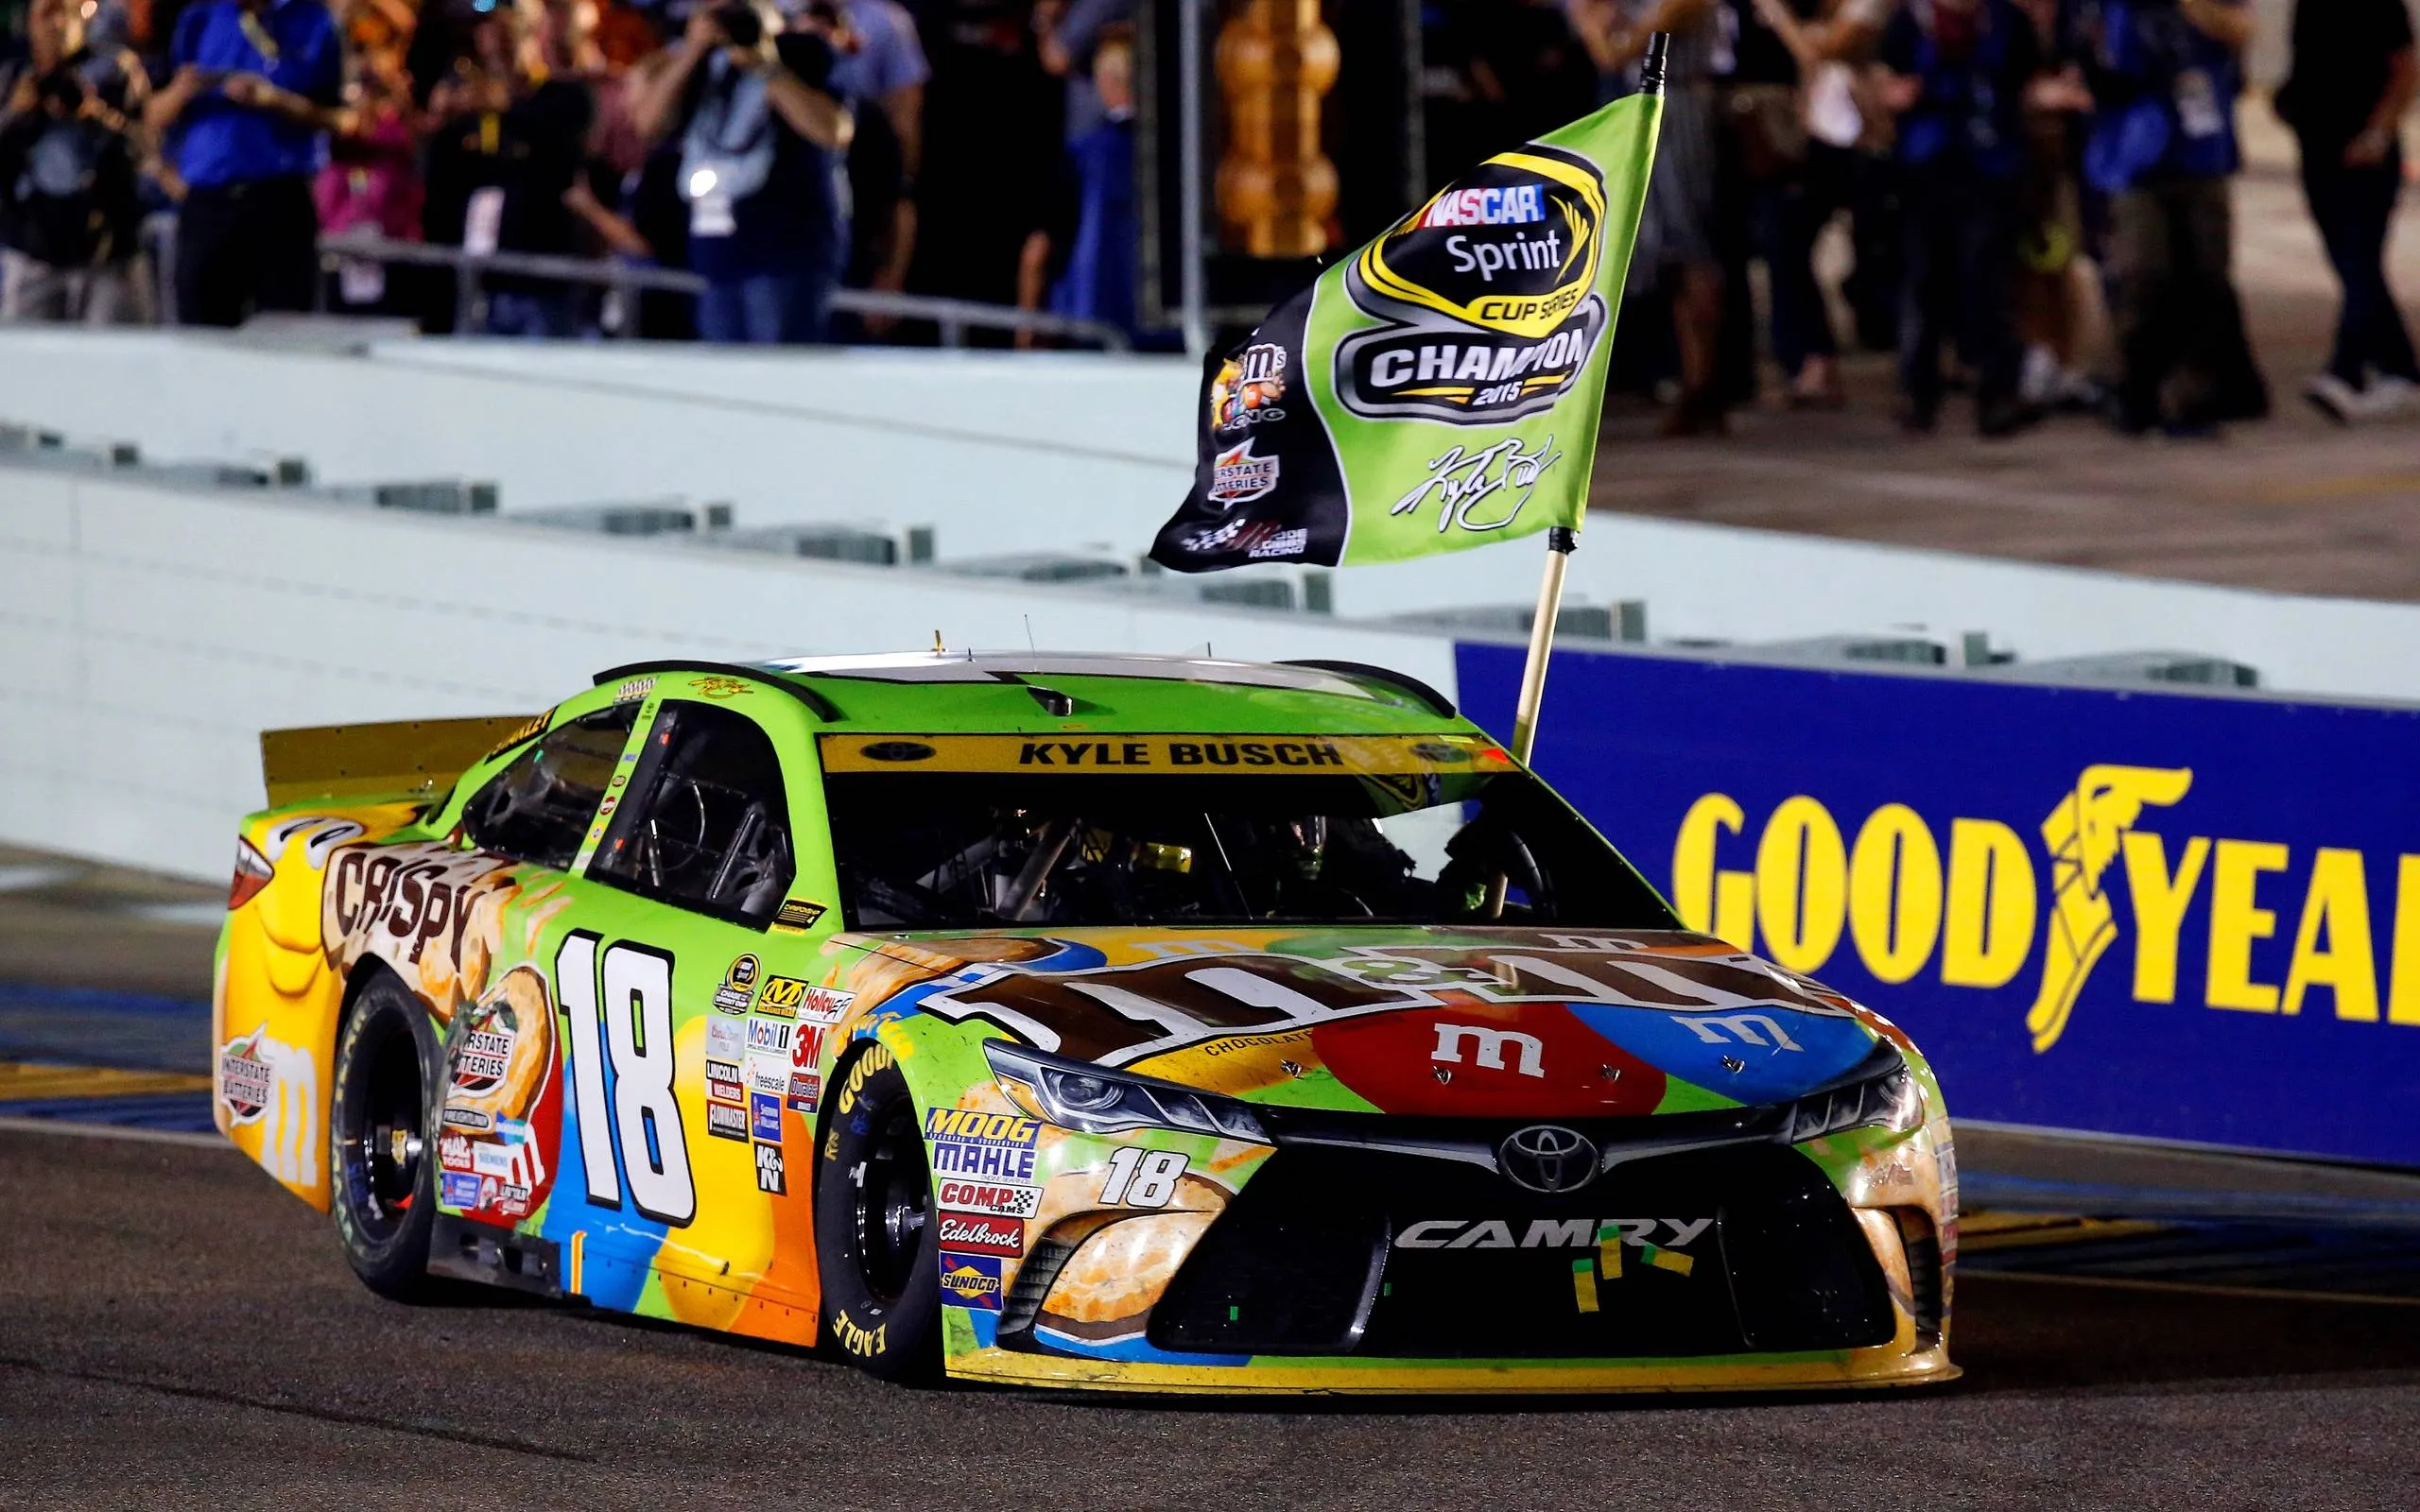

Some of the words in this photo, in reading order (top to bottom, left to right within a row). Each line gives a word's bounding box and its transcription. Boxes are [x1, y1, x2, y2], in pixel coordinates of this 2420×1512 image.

[1425, 185, 1540, 227] NASCAR
[1445, 230, 1561, 282] Sprint
[1480, 301, 1538, 320] CUP
[1370, 328, 1584, 387] CHAMPION
[1472, 381, 1523, 406] 2015
[1217, 462, 1271, 478] RSTATE
[1018, 742, 1151, 766] KYLE
[1168, 742, 1342, 766] BUSCH
[336, 851, 487, 973] CRISPY
[804, 988, 835, 1020] Holley
[468, 1032, 510, 1056] RSTATE
[748, 1019, 778, 1047] Mobil
[780, 1024, 790, 1049] 1
[792, 1023, 826, 1070] 3M
[1670, 1012, 1805, 1053] m
[1431, 1022, 1545, 1079] m
[223, 1057, 271, 1083] INTERSTATE
[555, 927, 697, 1228] 18
[707, 1061, 738, 1083] LINCOLN
[755, 1072, 786, 1091] freescale
[223, 1082, 268, 1105] BATTERIES
[928, 1108, 1041, 1143] MOOG
[933, 1142, 1036, 1178] MAHLE
[1098, 1145, 1191, 1209] 18
[941, 1182, 1014, 1208] COMP
[990, 1204, 1026, 1214] CAMS
[939, 1218, 1020, 1248] Edelbrock
[1393, 1218, 1714, 1248] CAMRY
[942, 1274, 996, 1292] SUNOCO
[833, 1308, 887, 1358] EAGLE
